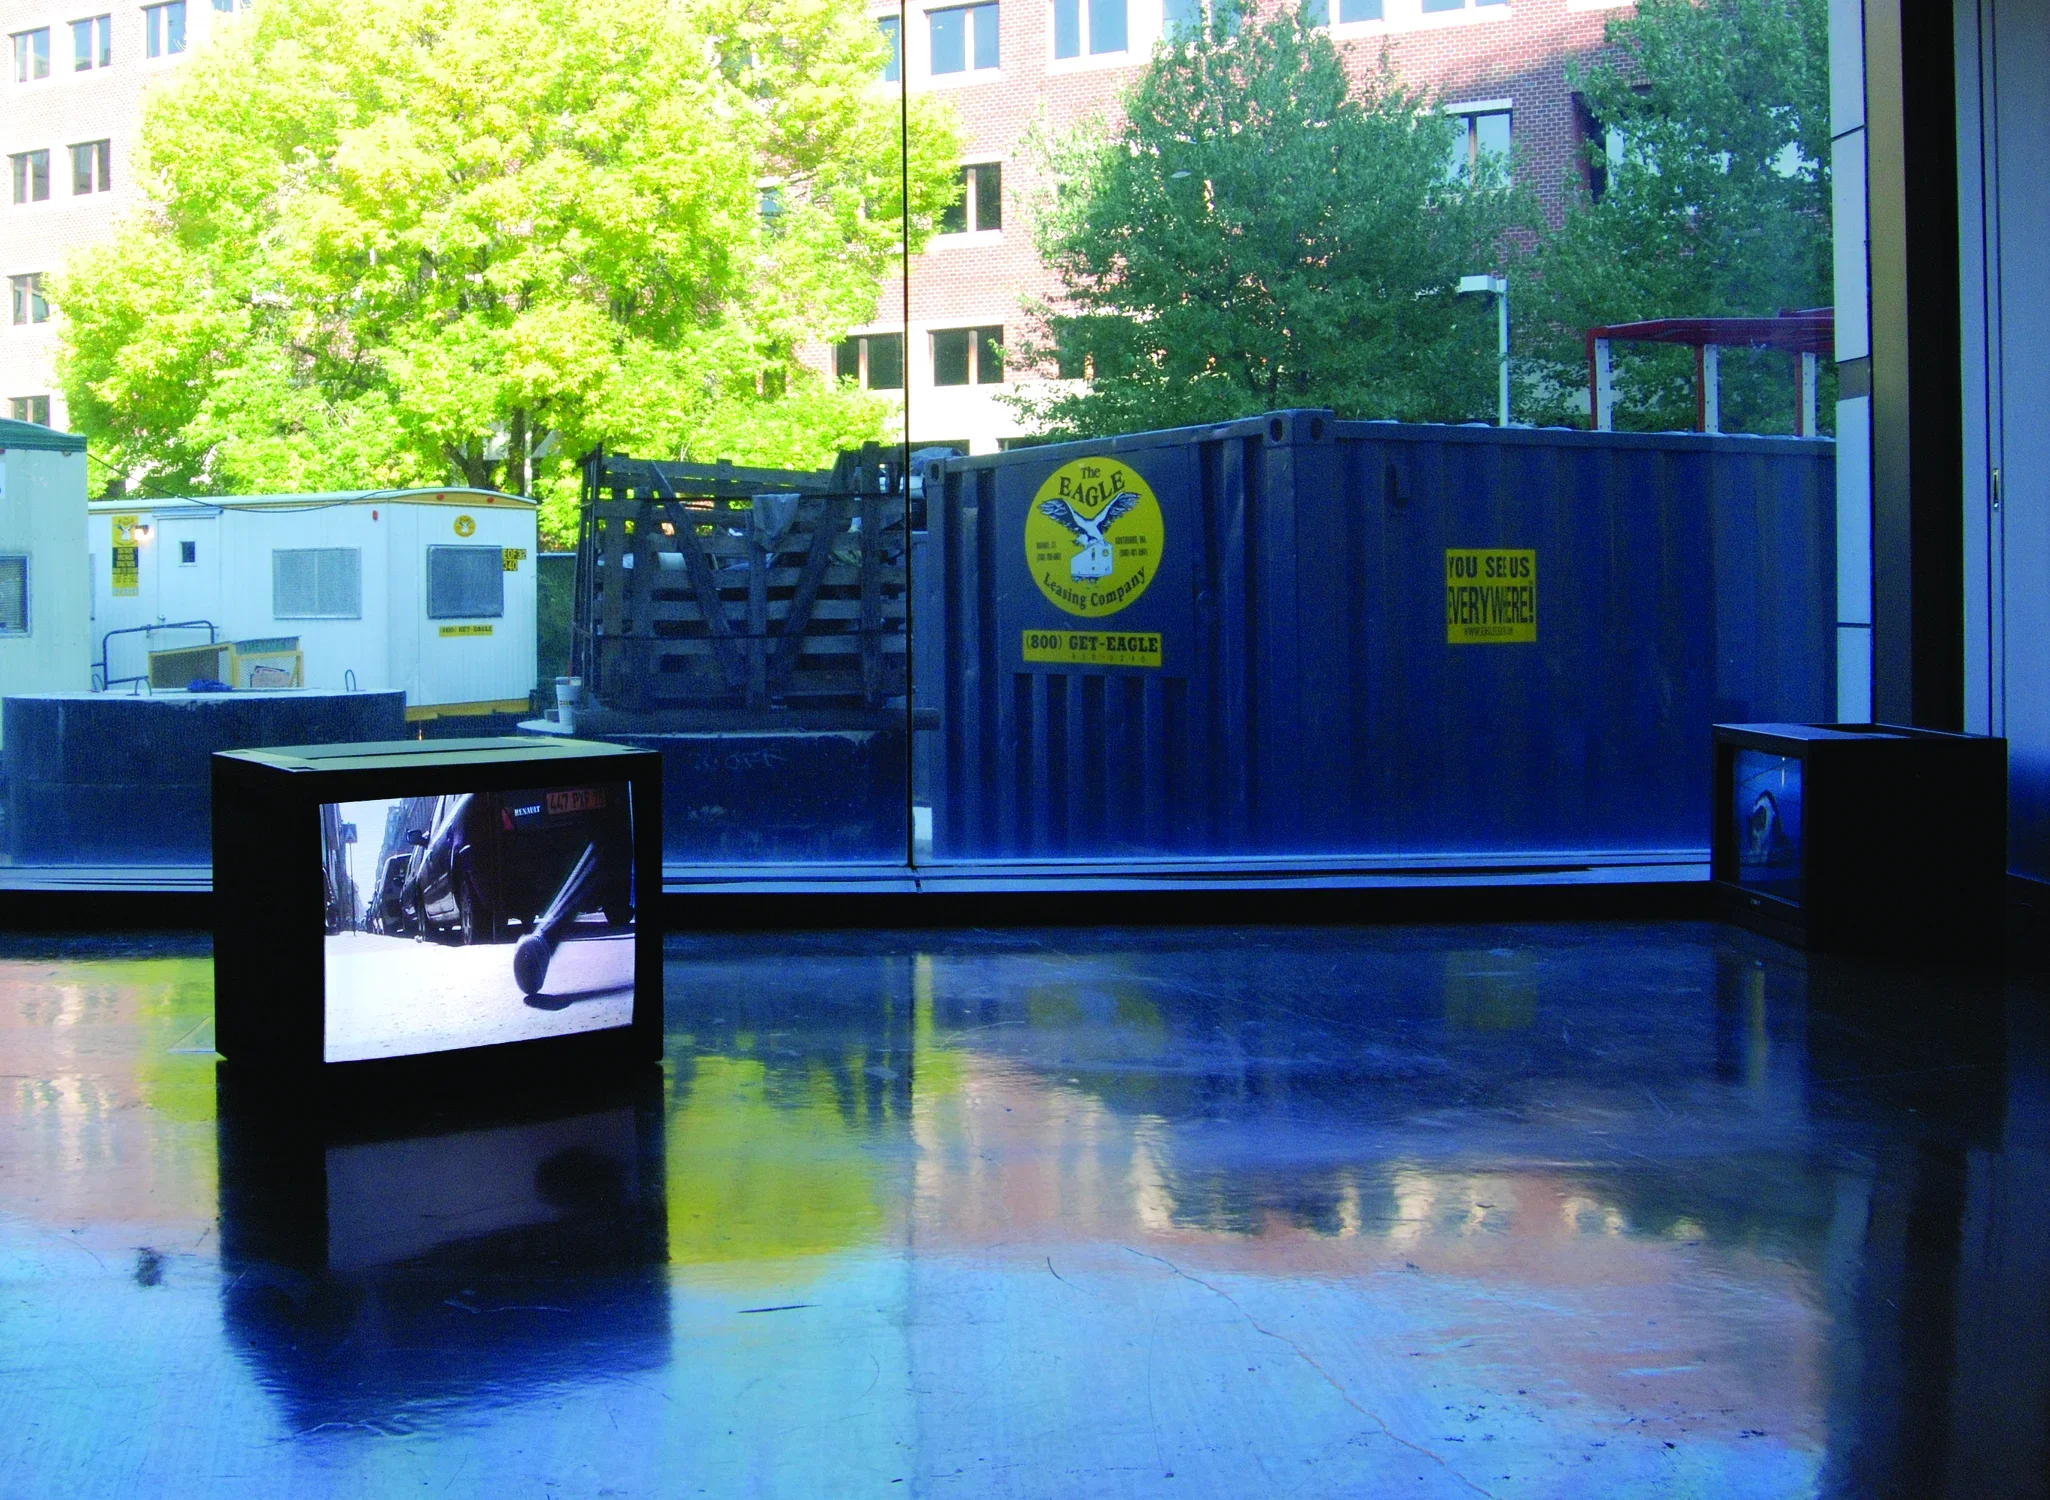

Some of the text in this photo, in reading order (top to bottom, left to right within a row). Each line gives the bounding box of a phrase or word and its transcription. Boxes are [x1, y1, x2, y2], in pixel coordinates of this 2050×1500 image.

[1081, 466, 1101, 479] The
[1058, 470, 1125, 507] EAGLE
[1448, 556, 1478, 578] YOU
[1509, 556, 1530, 578] US
[1043, 566, 1146, 610] Leasing Company
[1026, 635, 1158, 653] (800) GET-EAGLE
[514, 805, 541, 817] RENAULT
